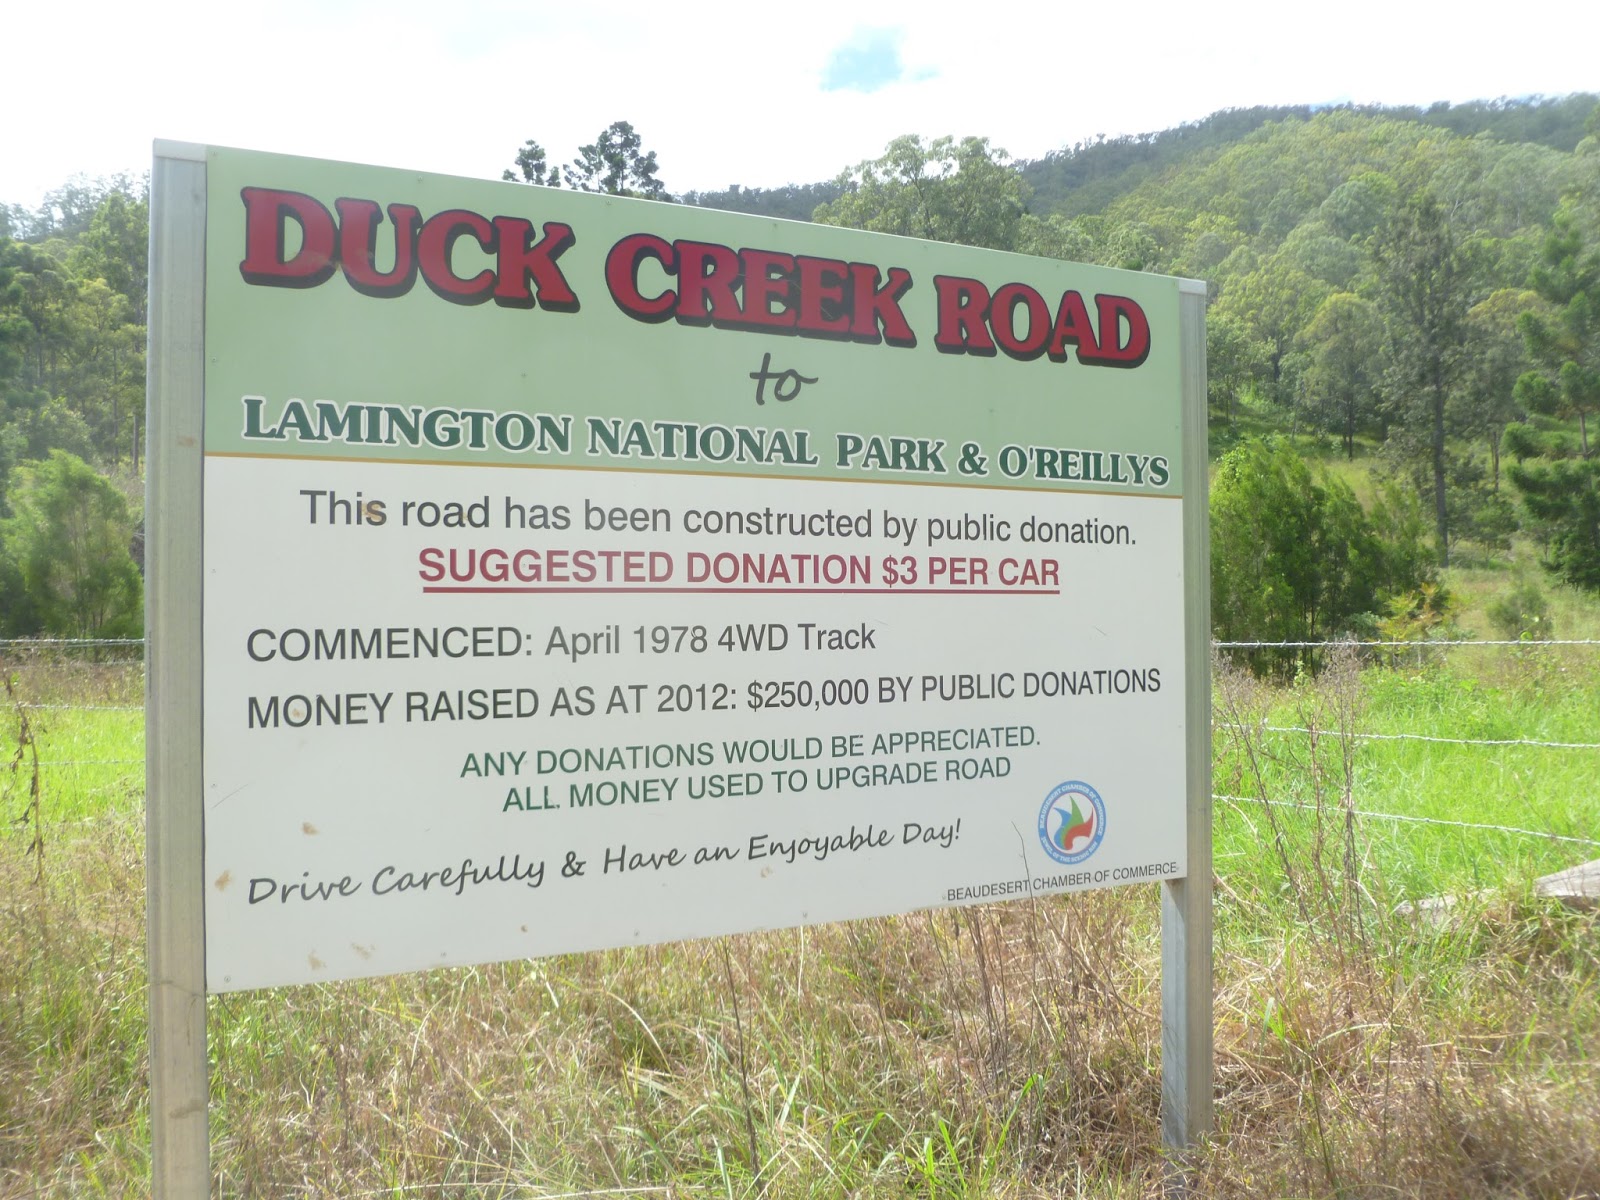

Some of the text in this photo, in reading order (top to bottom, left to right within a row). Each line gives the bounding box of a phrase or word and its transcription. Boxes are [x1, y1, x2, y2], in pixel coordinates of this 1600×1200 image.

[239, 187, 1151, 369] DUCK CREEK ROAD
[750, 353, 818, 405] to
[244, 399, 1169, 486] LAMINGTON NATIONAL PARK & O'REILLYS
[300, 490, 1135, 546] This road has been constructed by public donation.
[419, 548, 1059, 588] SUGGESTED DONATION $3 PER CAR
[247, 623, 875, 663] COMMENCED: April 1978 4WD Track
[249, 668, 1160, 728] MONEY RAISED AS AT 2012: $250,000 BY PUBLIC DONATIONS
[460, 726, 1040, 777] ANY DONATIONS WOULD BE APPRECIATED.
[503, 757, 1010, 812] ALL MONEY USED TO UPGRADE ROAD
[1062, 784, 1089, 794] CHAMBER
[249, 818, 960, 904] Drive Carefully & Have an Enjoyable Day!
[947, 862, 1176, 901] BEAUDESERT CHAMBER OF COMMERCE
